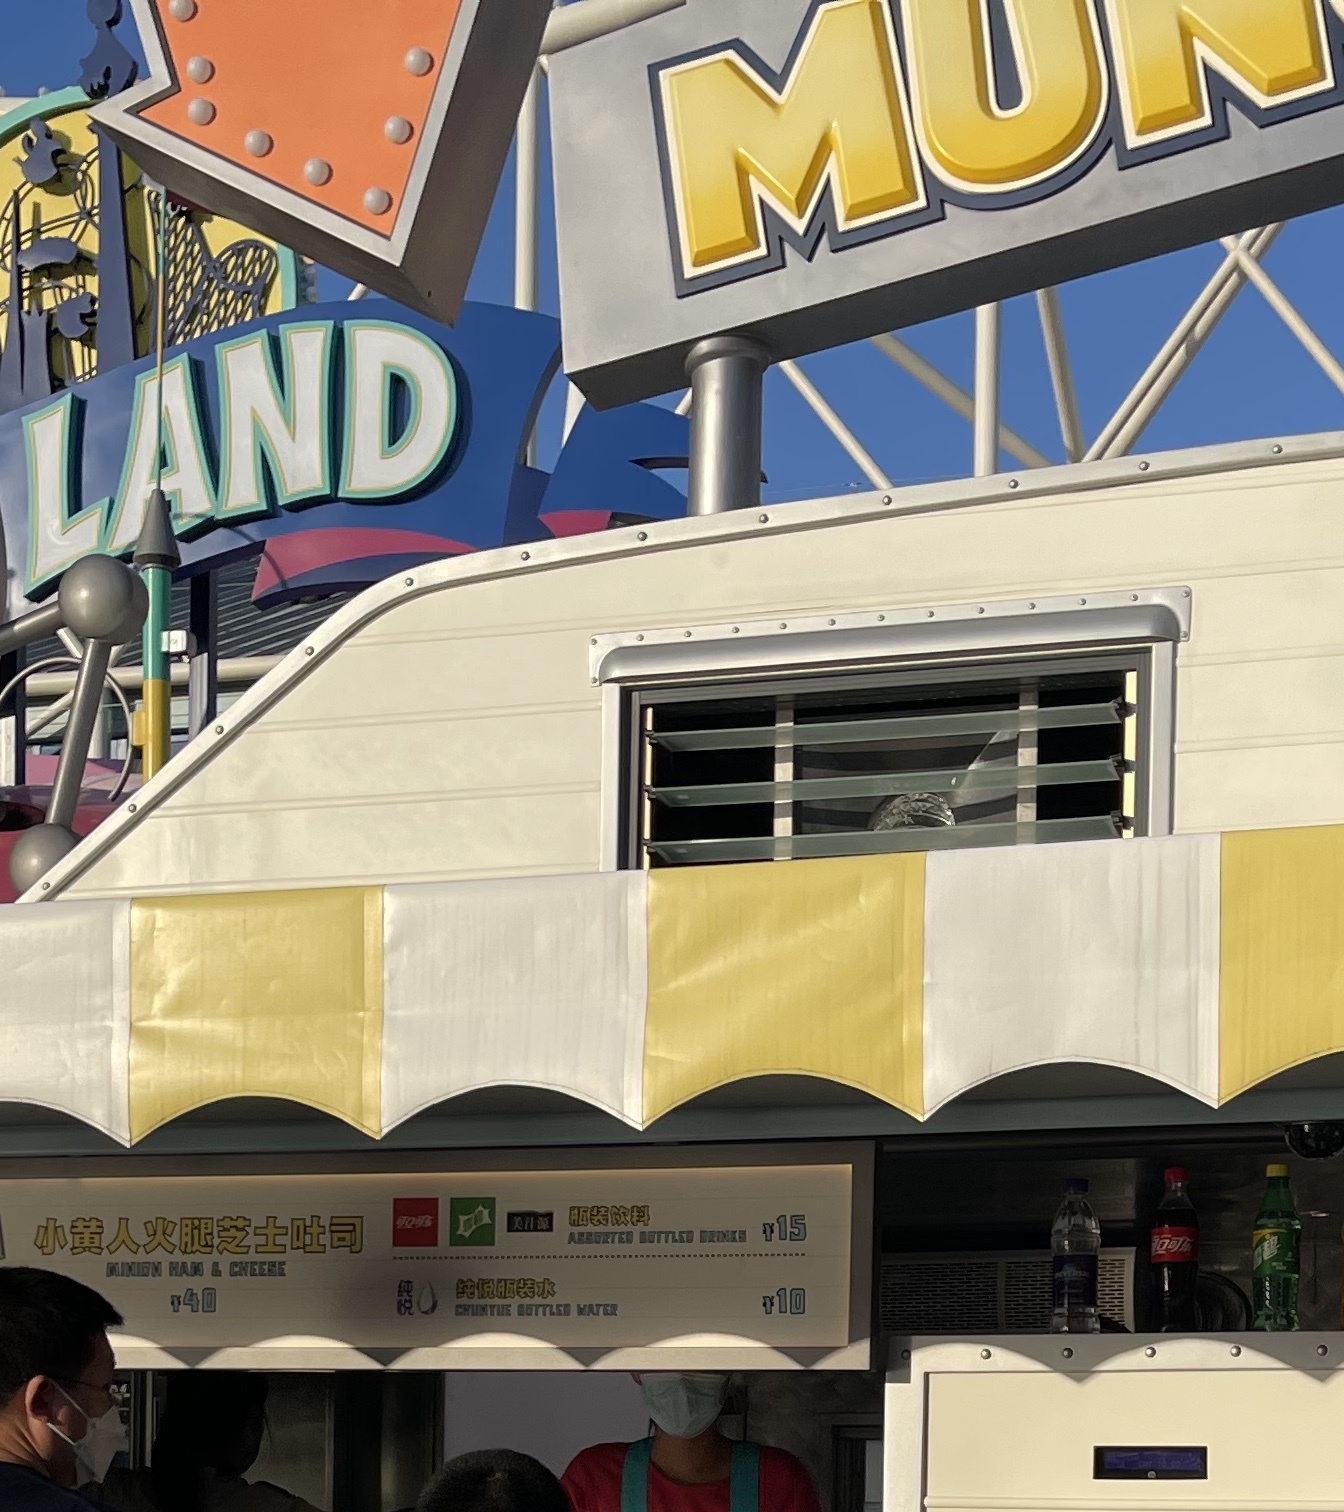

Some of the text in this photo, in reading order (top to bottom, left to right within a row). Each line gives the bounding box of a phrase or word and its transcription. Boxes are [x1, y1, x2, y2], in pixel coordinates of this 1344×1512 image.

[21, 318, 457, 598] LAND
[568, 1205, 651, 1227] 瓶装饮料
[762, 1214, 807, 1242] ¥15
[34, 1214, 365, 1255] 小黄人火腿芝士吐司
[168, 1261, 204, 1277] HAM
[229, 1260, 287, 1277] CHEESE
[576, 1303, 618, 1316] WATER
[762, 1288, 806, 1314] ¥10
